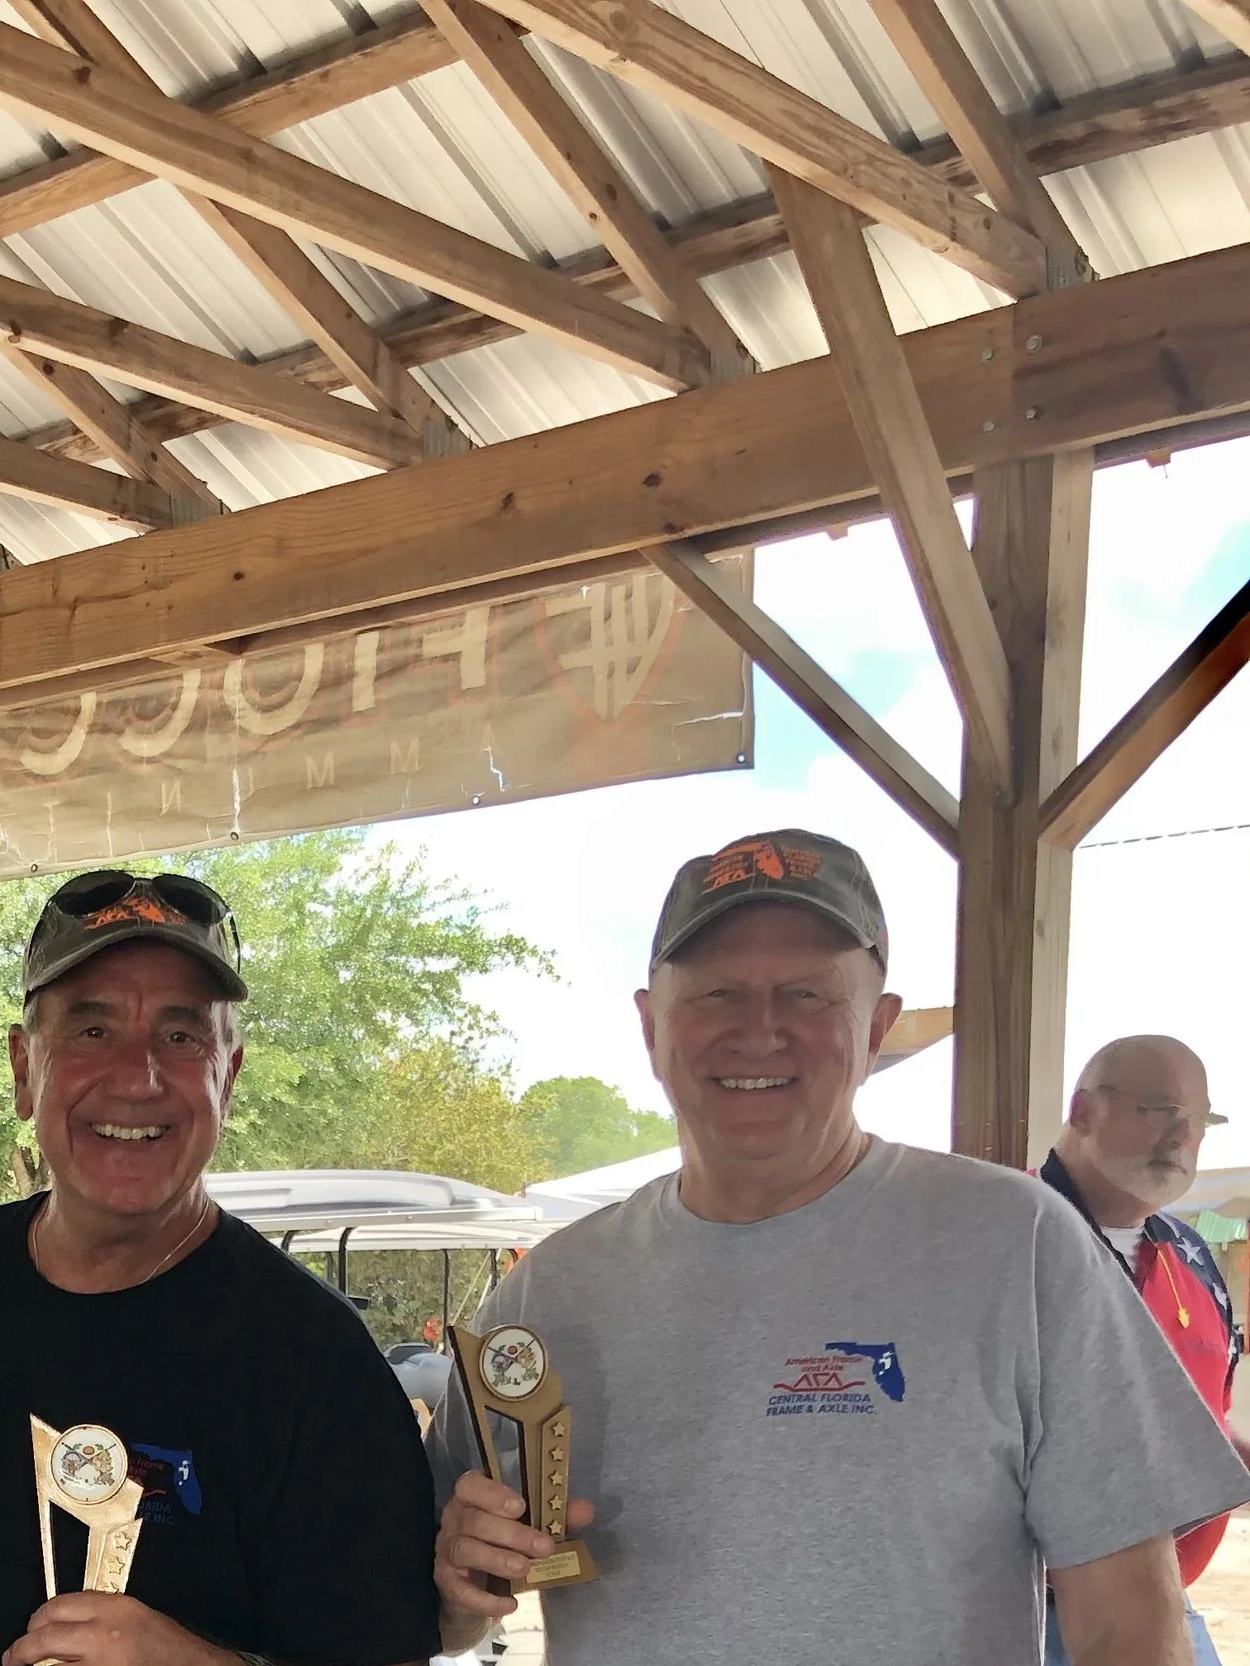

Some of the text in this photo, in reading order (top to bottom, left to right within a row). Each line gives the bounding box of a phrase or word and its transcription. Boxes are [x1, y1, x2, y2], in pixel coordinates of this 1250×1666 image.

[769, 1393, 871, 1406] CENTRAL FLORIDA
[766, 1404, 804, 1417] FRAME
[818, 1404, 849, 1414] AXLE
